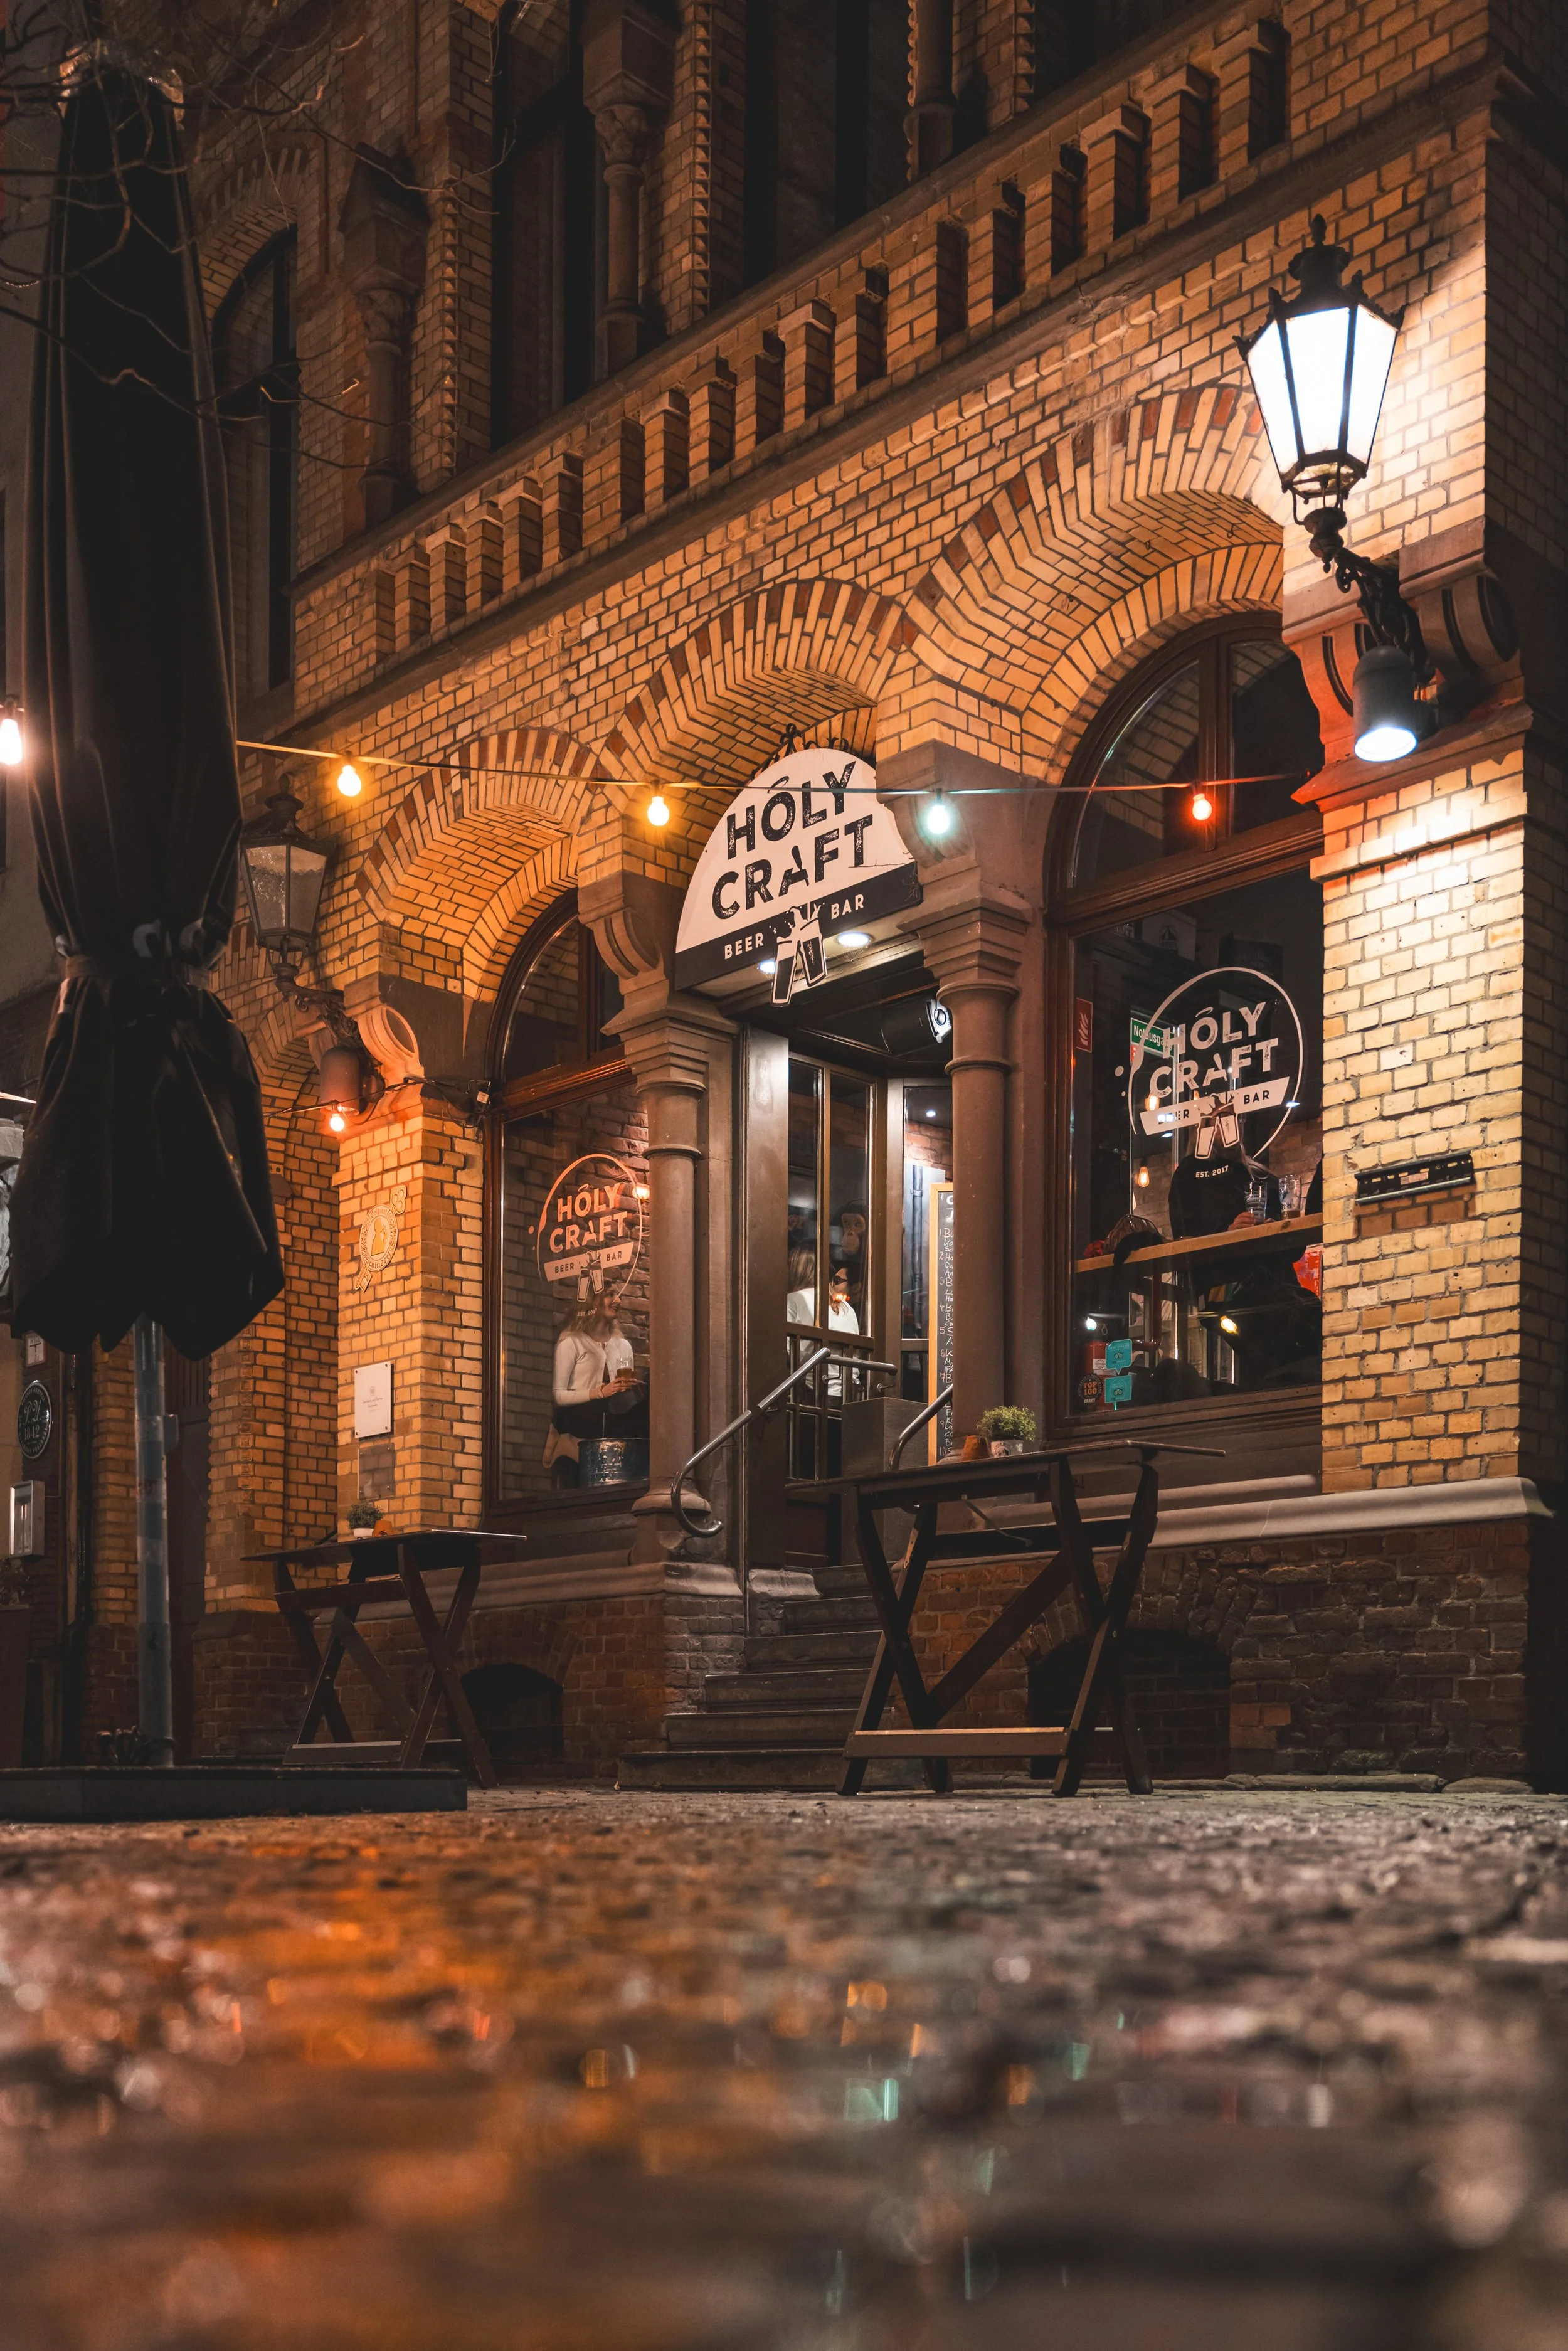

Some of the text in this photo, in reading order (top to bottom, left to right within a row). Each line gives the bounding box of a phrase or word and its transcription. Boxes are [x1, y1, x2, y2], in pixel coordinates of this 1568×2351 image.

[726, 761, 856, 860] HOLY
[712, 814, 873, 920] CRAFT
[724, 894, 864, 960] BEER BAR
[1163, 1002, 1266, 1059] HOLY
[1150, 1038, 1279, 1098] CRAFT
[1243, 1090, 1269, 1105] BAR
[1212, 1165, 1228, 1176] 2017
[558, 1183, 621, 1223] HOLY
[549, 1211, 628, 1253] CRAFT
[554, 1251, 622, 1273] BEER BAR
[24, 1425, 40, 1440] 1842
